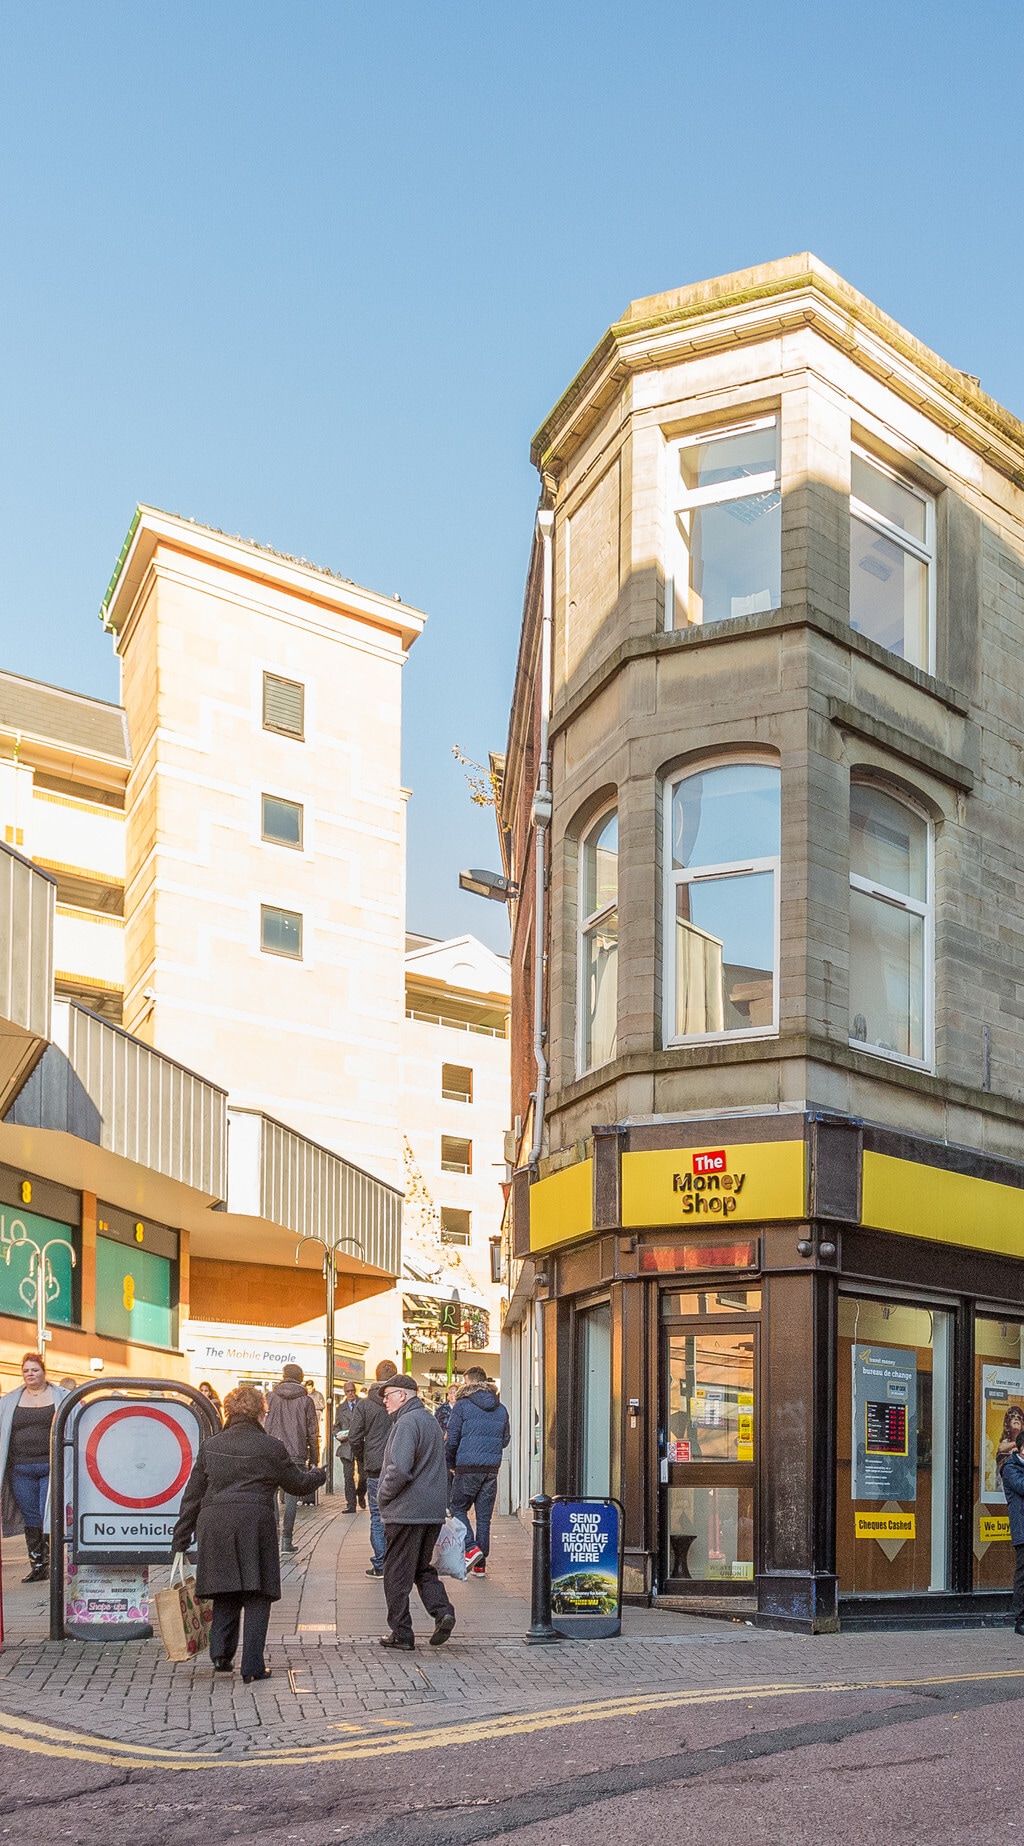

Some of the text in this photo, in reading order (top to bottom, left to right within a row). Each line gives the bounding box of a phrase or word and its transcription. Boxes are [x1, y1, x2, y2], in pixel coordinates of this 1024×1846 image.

[695, 1155, 723, 1171] The
[673, 1172, 746, 1194] Money
[682, 1193, 737, 1217] Shop
[205, 1347, 297, 1364] The Mobile People
[862, 1366, 912, 1380] bureau de change
[569, 1512, 601, 1524] SEND
[94, 1523, 176, 1536] No vehicle
[572, 1523, 598, 1533] AND
[858, 1519, 912, 1531] Cheques Cashed
[984, 1520, 1011, 1533] We buy
[561, 1532, 609, 1543] RECEIVE
[563, 1542, 606, 1553] MONEY
[570, 1552, 600, 1563] HERE
